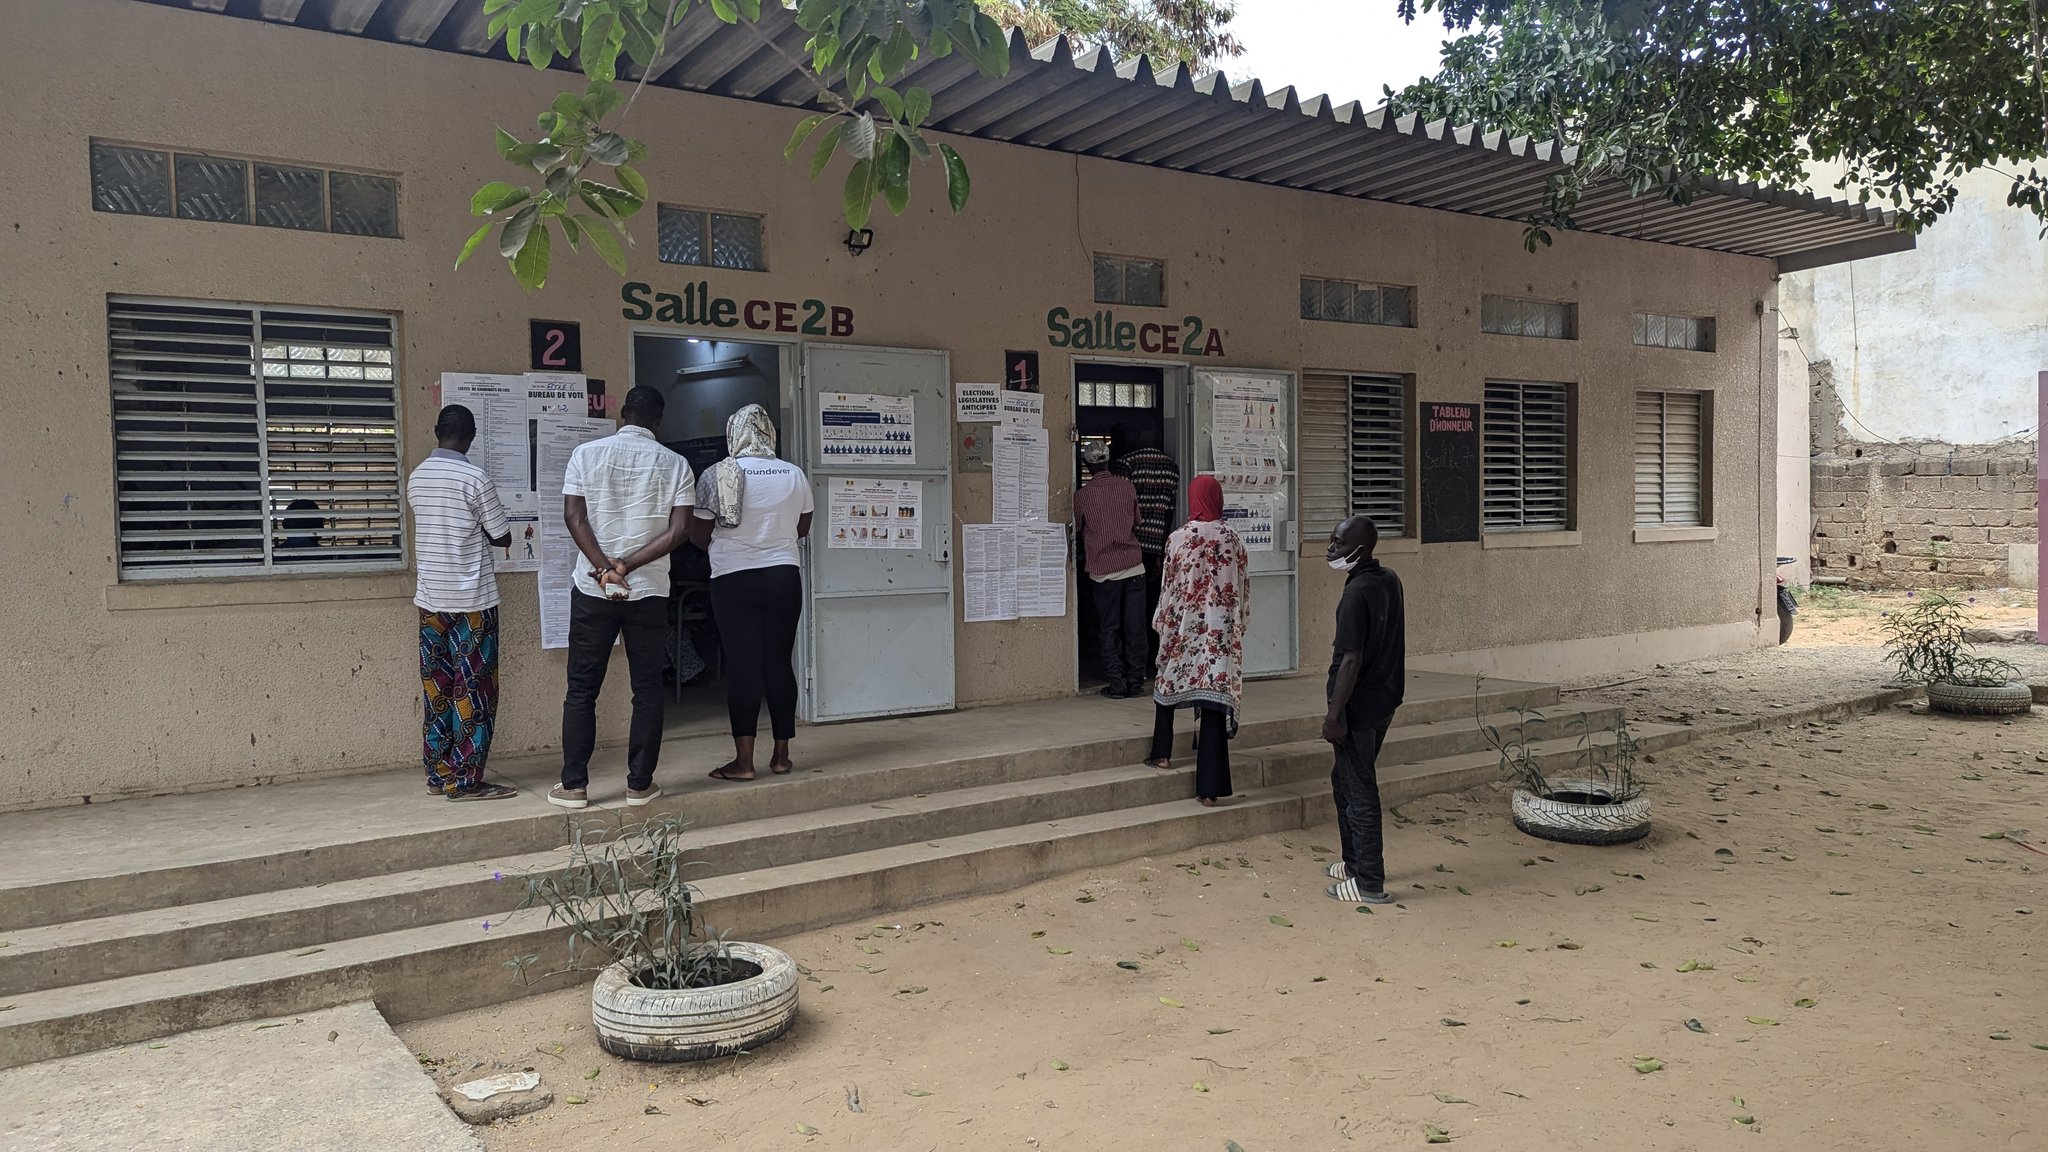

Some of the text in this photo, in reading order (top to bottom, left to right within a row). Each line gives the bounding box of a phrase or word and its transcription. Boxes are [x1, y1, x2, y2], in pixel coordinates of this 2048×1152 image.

[621, 280, 855, 337] Salle CE2B
[1046, 306, 1226, 357] Salle CE2A
[542, 328, 566, 366] 2
[1014, 359, 1029, 390] 1
[528, 391, 584, 399] BUREAU DE VOTE
[1004, 405, 1022, 413] BUREAU
[1030, 407, 1041, 415] VOTE
[1432, 405, 1471, 418] TABLEAU
[1429, 418, 1474, 432] D'HONNEUR
[743, 467, 791, 476] foundever
